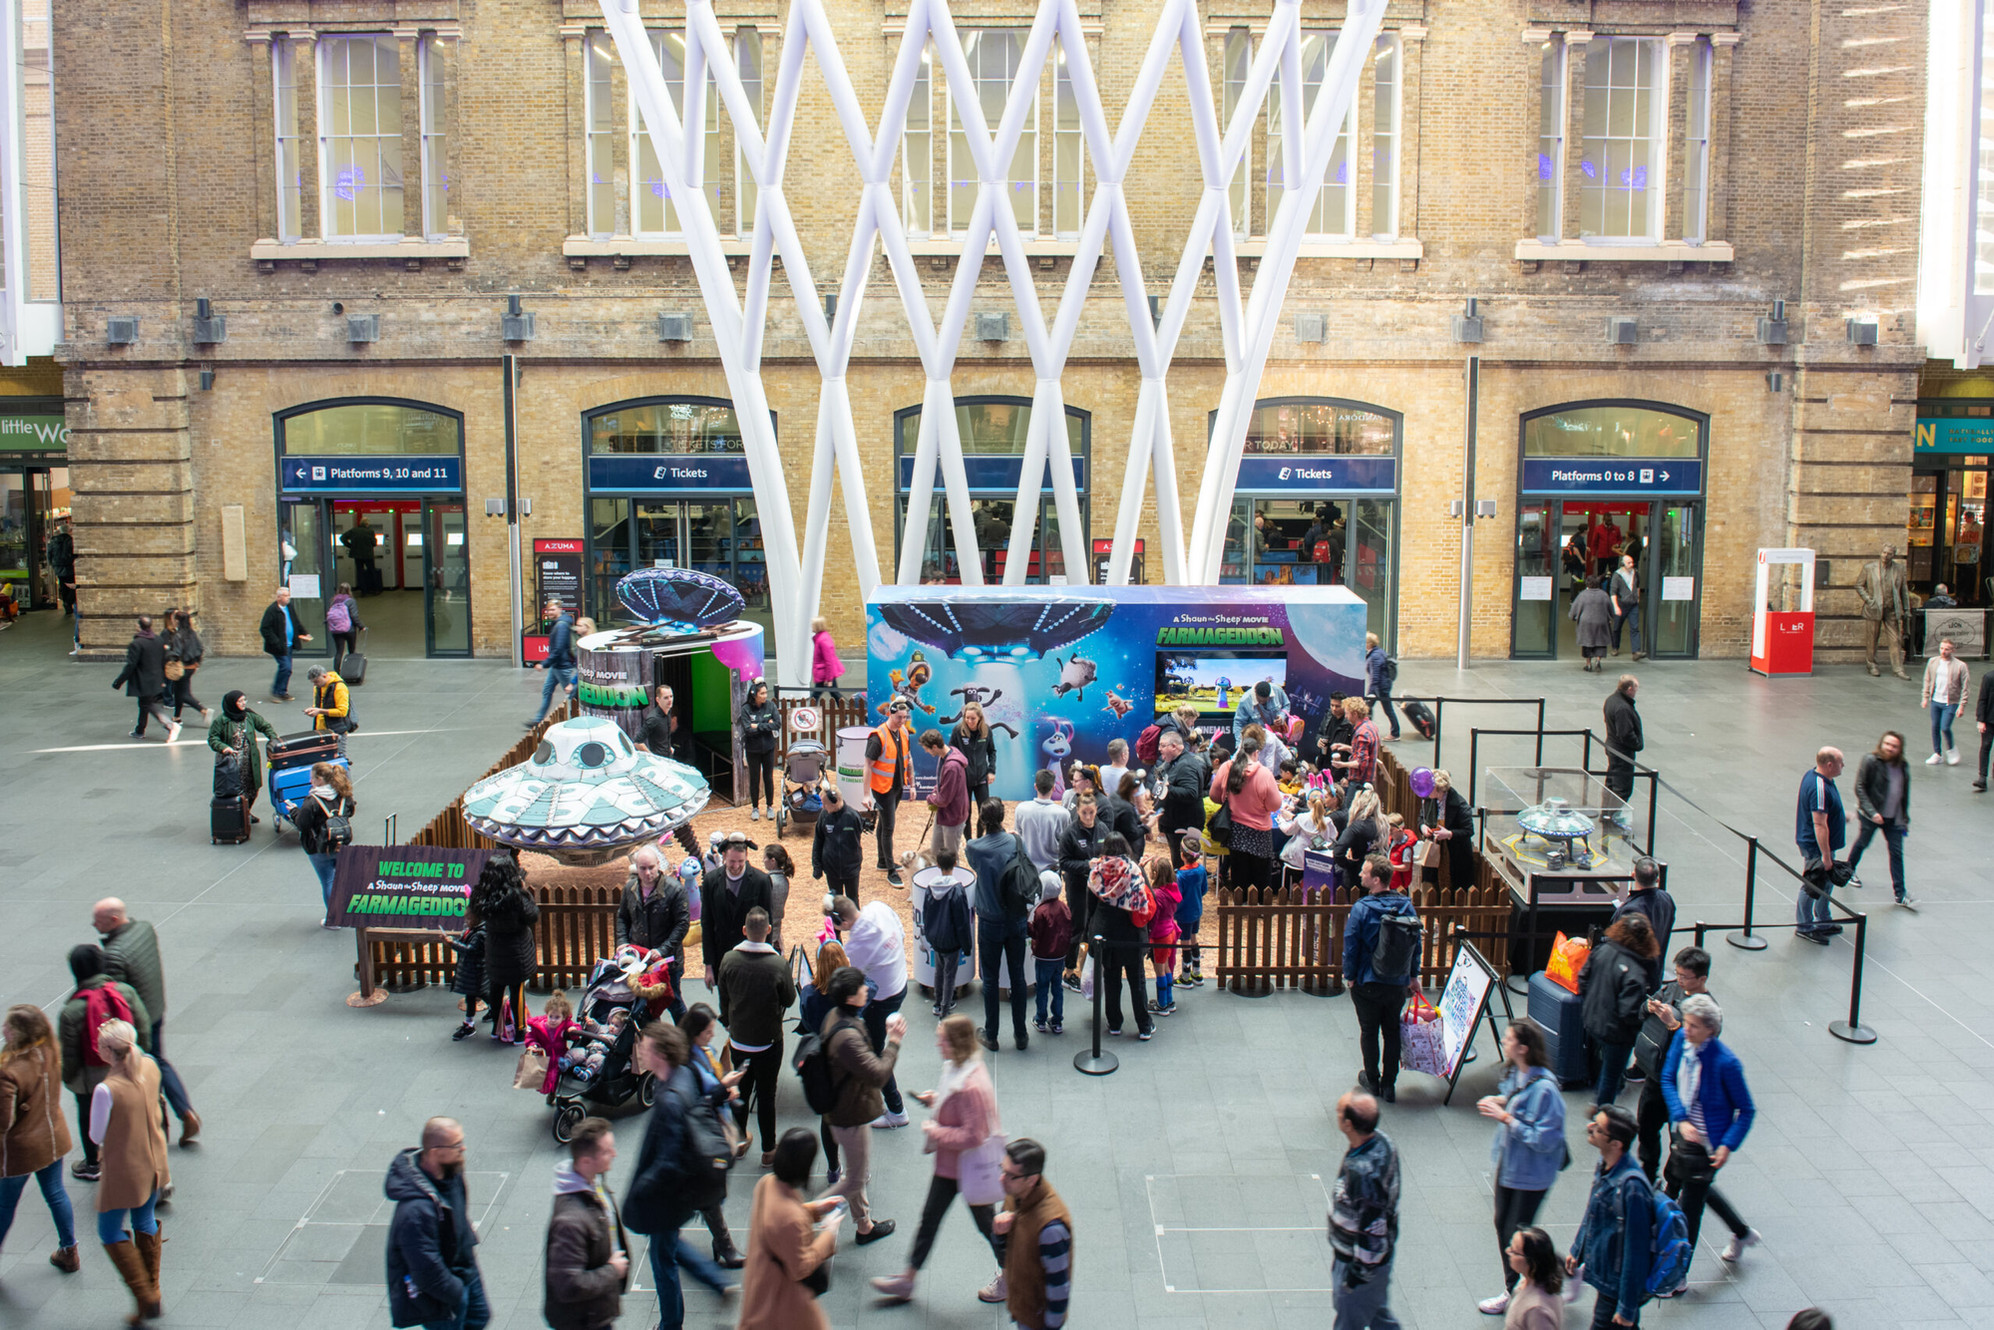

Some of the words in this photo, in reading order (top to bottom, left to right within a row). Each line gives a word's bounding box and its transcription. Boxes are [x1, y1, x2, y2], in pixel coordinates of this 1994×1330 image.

[1, 419, 33, 434] little
[331, 468, 381, 479] Platforms
[383, 468, 393, 480] 9,
[396, 468, 409, 479] 10
[411, 468, 431, 479] and
[434, 468, 448, 478] 11
[671, 468, 708, 478] Tickets
[1295, 468, 1332, 479] Tickets
[1552, 470, 1602, 482] Platforms
[1604, 470, 1612, 481] 0
[1613, 471, 1626, 481] to
[1627, 470, 1635, 481] 8
[1181, 613, 1207, 623] Shaun
[1215, 613, 1241, 625] Sheep
[1156, 627, 1284, 646] FARMAGEDDON
[596, 671, 628, 680] MOVIE
[378, 861, 444, 878] WELCOME
[447, 863, 465, 878] TO
[367, 882, 375, 890] A
[376, 880, 403, 890] Shaun
[411, 882, 438, 894] Sheep
